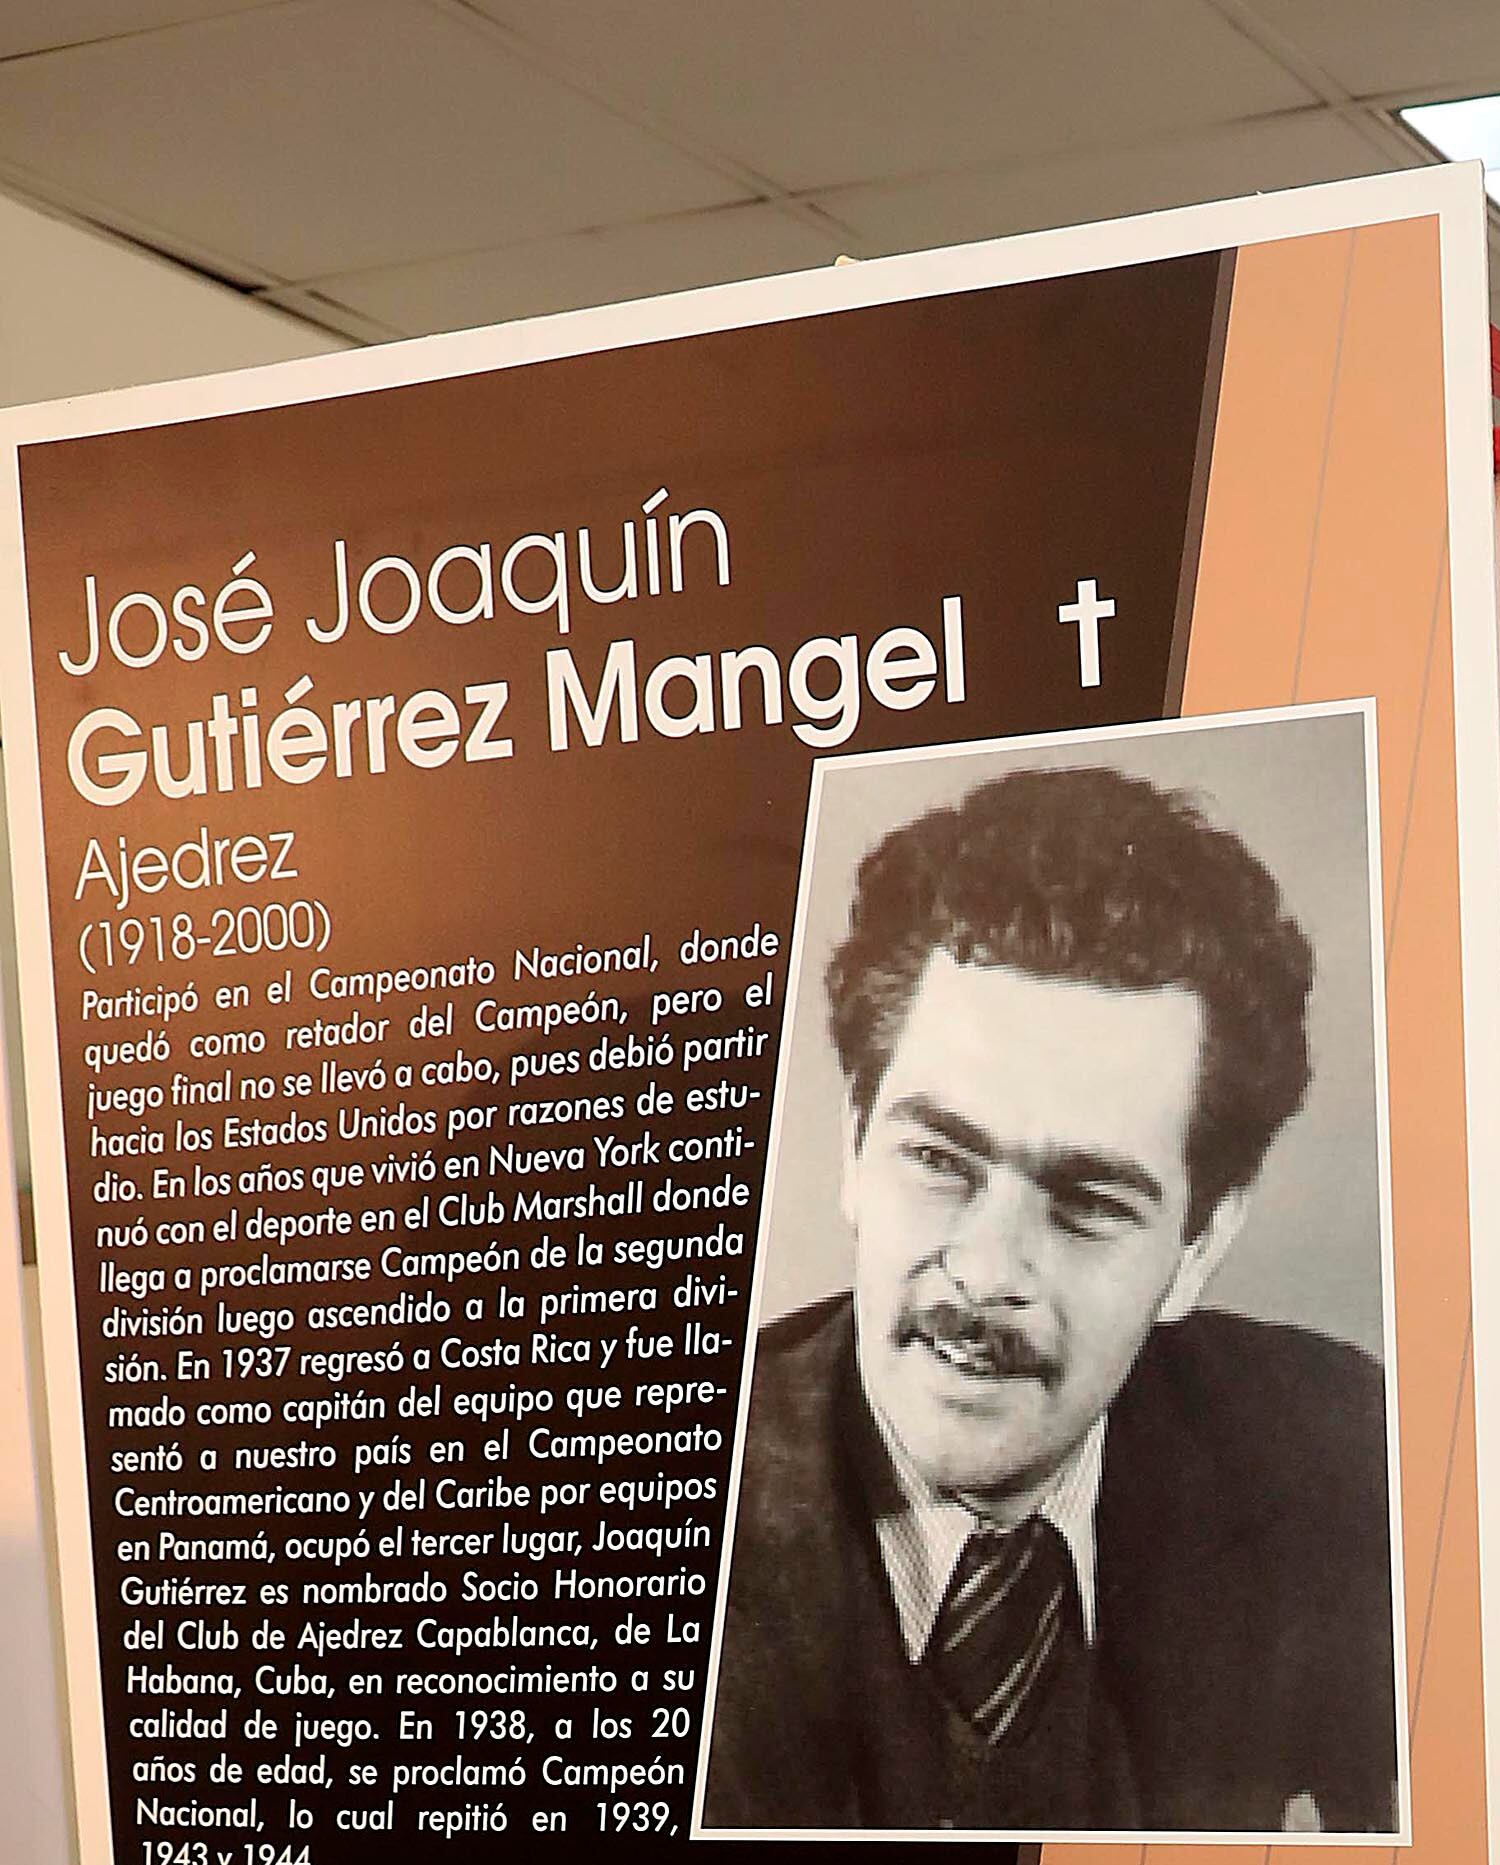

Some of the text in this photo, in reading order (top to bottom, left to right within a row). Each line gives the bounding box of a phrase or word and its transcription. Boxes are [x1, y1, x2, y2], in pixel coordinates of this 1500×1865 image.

[58, 487, 730, 676] José Joaquín
[67, 596, 965, 806] Gutiérrez Mangel
[74, 826, 298, 911] Ajedrez
[79, 900, 331, 975] (1918-2000)
[82, 923, 779, 1023] Participó en el Campeonato Nacional, donde
[84, 971, 773, 1074] quedó como retador del Campeón, pero el
[88, 1026, 769, 1120] juego final no se llevó a cabo, pues debió partir
[91, 1080, 761, 1157] hacia los Estados Unidos por razones de estu-
[93, 1126, 755, 1203] dio. En los años que vivió en Nueva York conti-
[97, 1173, 750, 1248] nuó con el deporte en el Club Marshall donde
[100, 1223, 744, 1299] llega a proclamarse Campeón de la segunda
[102, 1274, 738, 1339] división luego ascendido a la primera divi-
[104, 1322, 733, 1383] sión. En 1937 regresó a Costa Rica y fue lla-
[109, 1381, 727, 1429] mado como capitán del equipo que repre-
[111, 1423, 722, 1474] sentó a nuestro país en el Campeonato
[114, 1471, 717, 1520] Centroamericano y del Caribe por equipos
[117, 1517, 710, 1567] en Panamá, ocupó el tercer lugar, Joaquín
[121, 1566, 706, 1606] Gutiérrez es nombrado Socio Honorario
[123, 1612, 700, 1657] del Club de Ajedrez Capablanca, de La
[127, 1663, 695, 1699] Habana, Cuba, en reconocimiento a su
[129, 1707, 690, 1748] calidad de juego. En 1938, a los 20
[132, 1752, 684, 1794] años de edad, se proclamó Campeón
[136, 1797, 679, 1839] Nacional, lo cual repitió en 1939,
